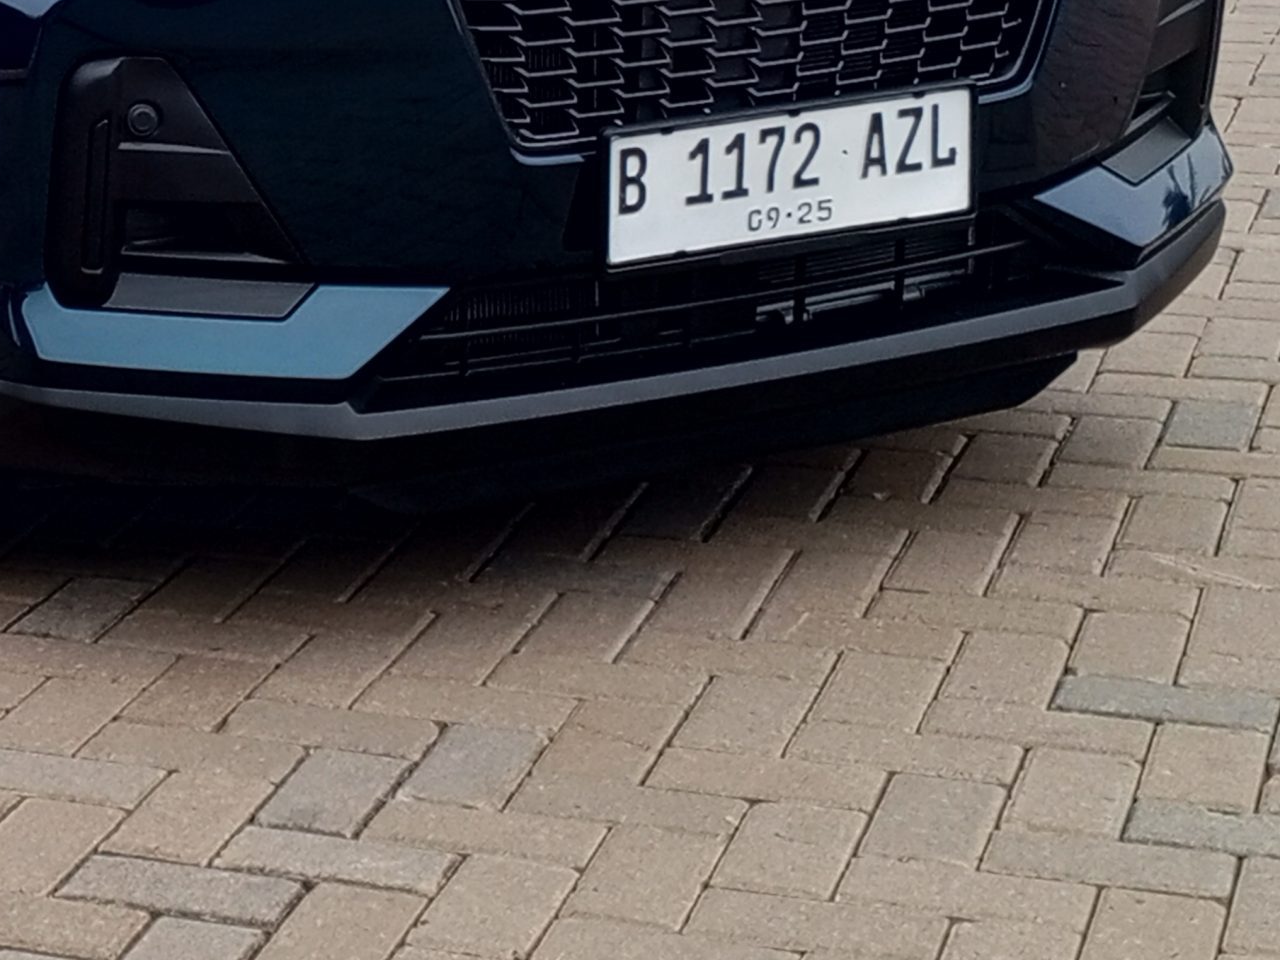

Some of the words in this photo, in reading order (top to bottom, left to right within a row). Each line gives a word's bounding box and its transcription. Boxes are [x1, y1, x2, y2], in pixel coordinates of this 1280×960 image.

[619, 146, 648, 215] B
[685, 122, 821, 206] 1172
[860, 103, 957, 179] AZL
